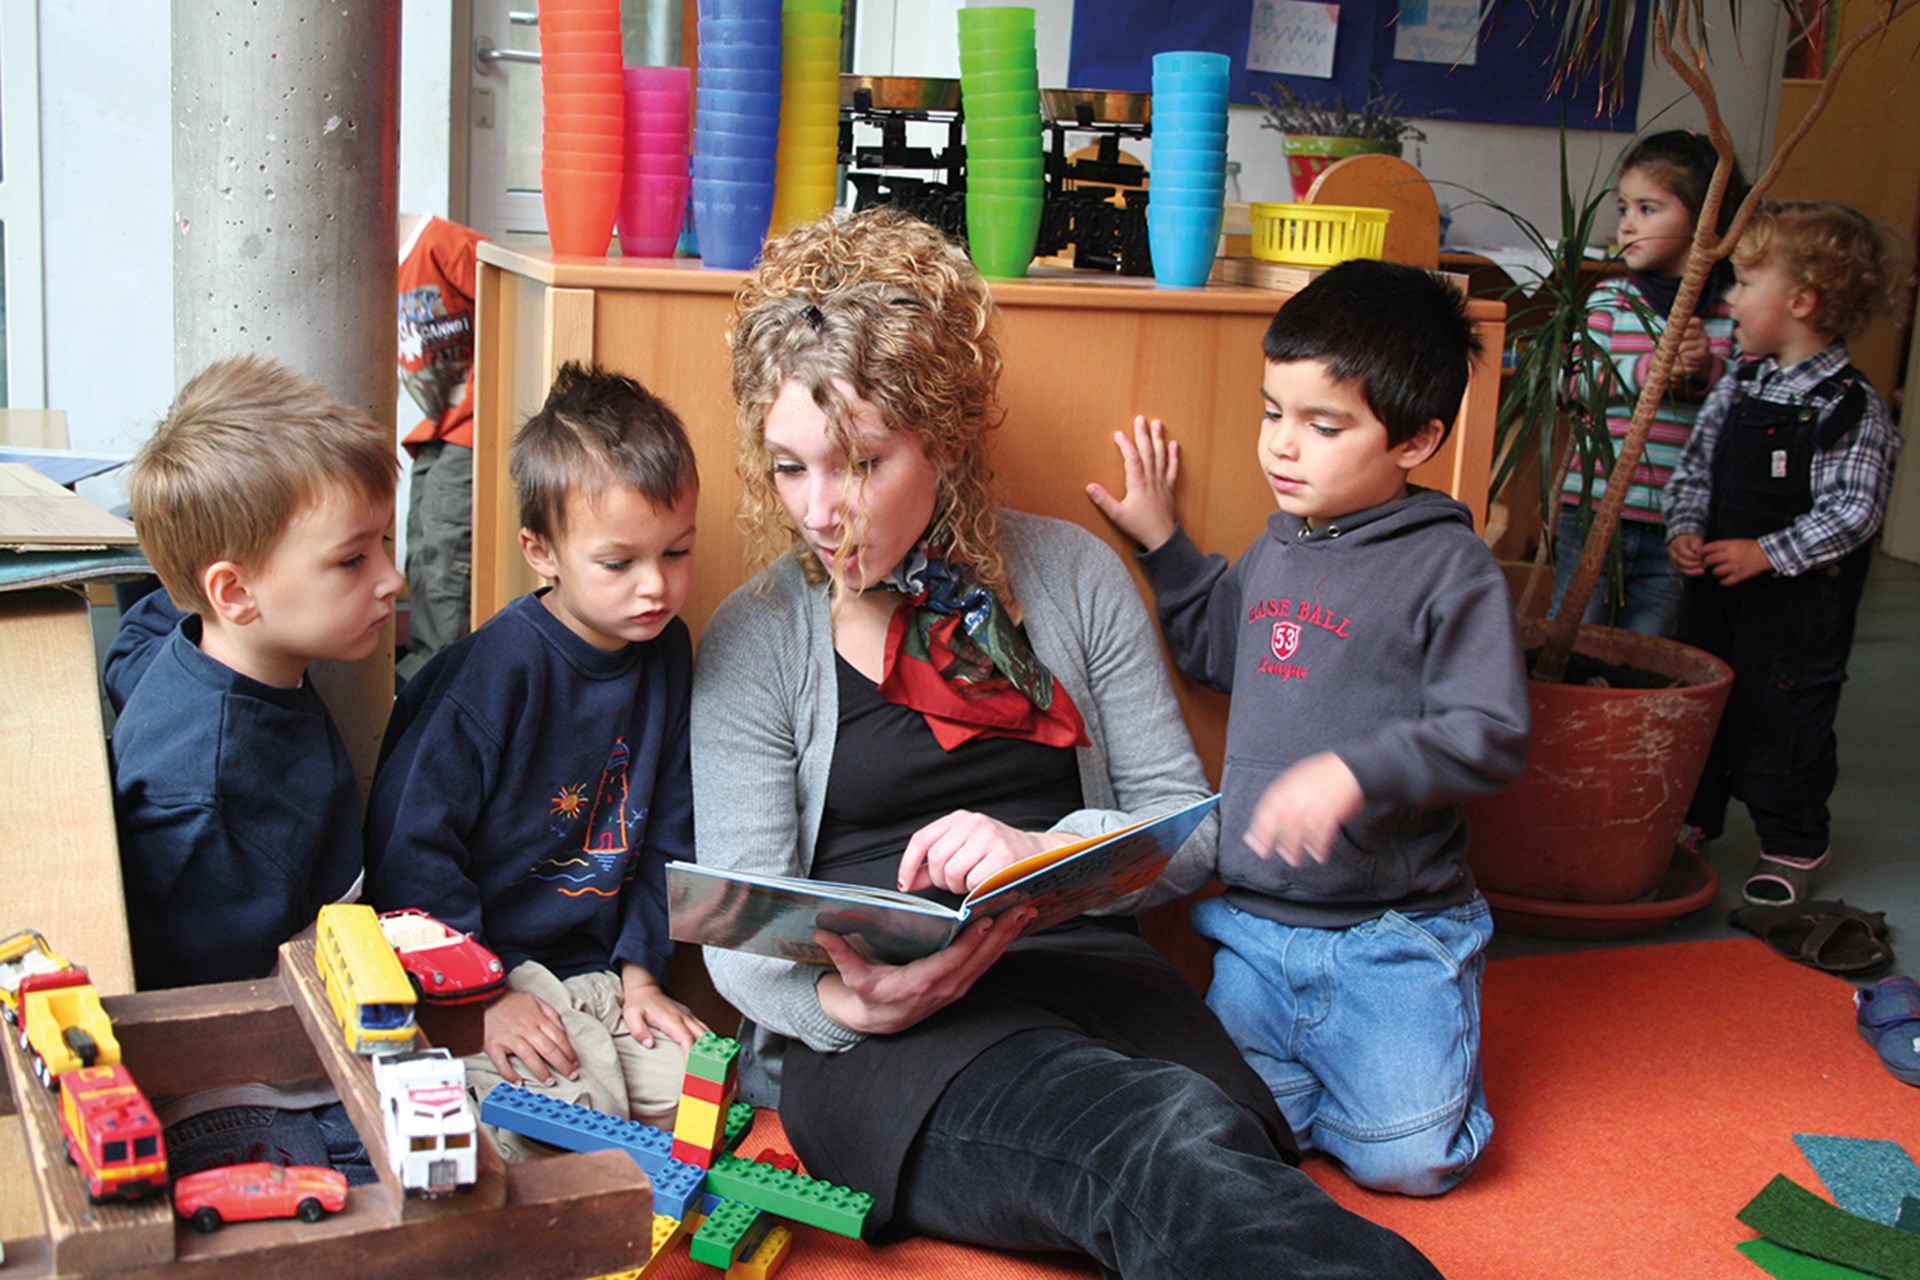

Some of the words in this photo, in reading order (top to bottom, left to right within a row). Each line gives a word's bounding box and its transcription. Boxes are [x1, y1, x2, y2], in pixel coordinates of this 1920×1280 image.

[1249, 598, 1291, 624] BASE
[1296, 601, 1351, 639] BALL
[1275, 628, 1295, 649] 53
[1257, 656, 1308, 681] League
